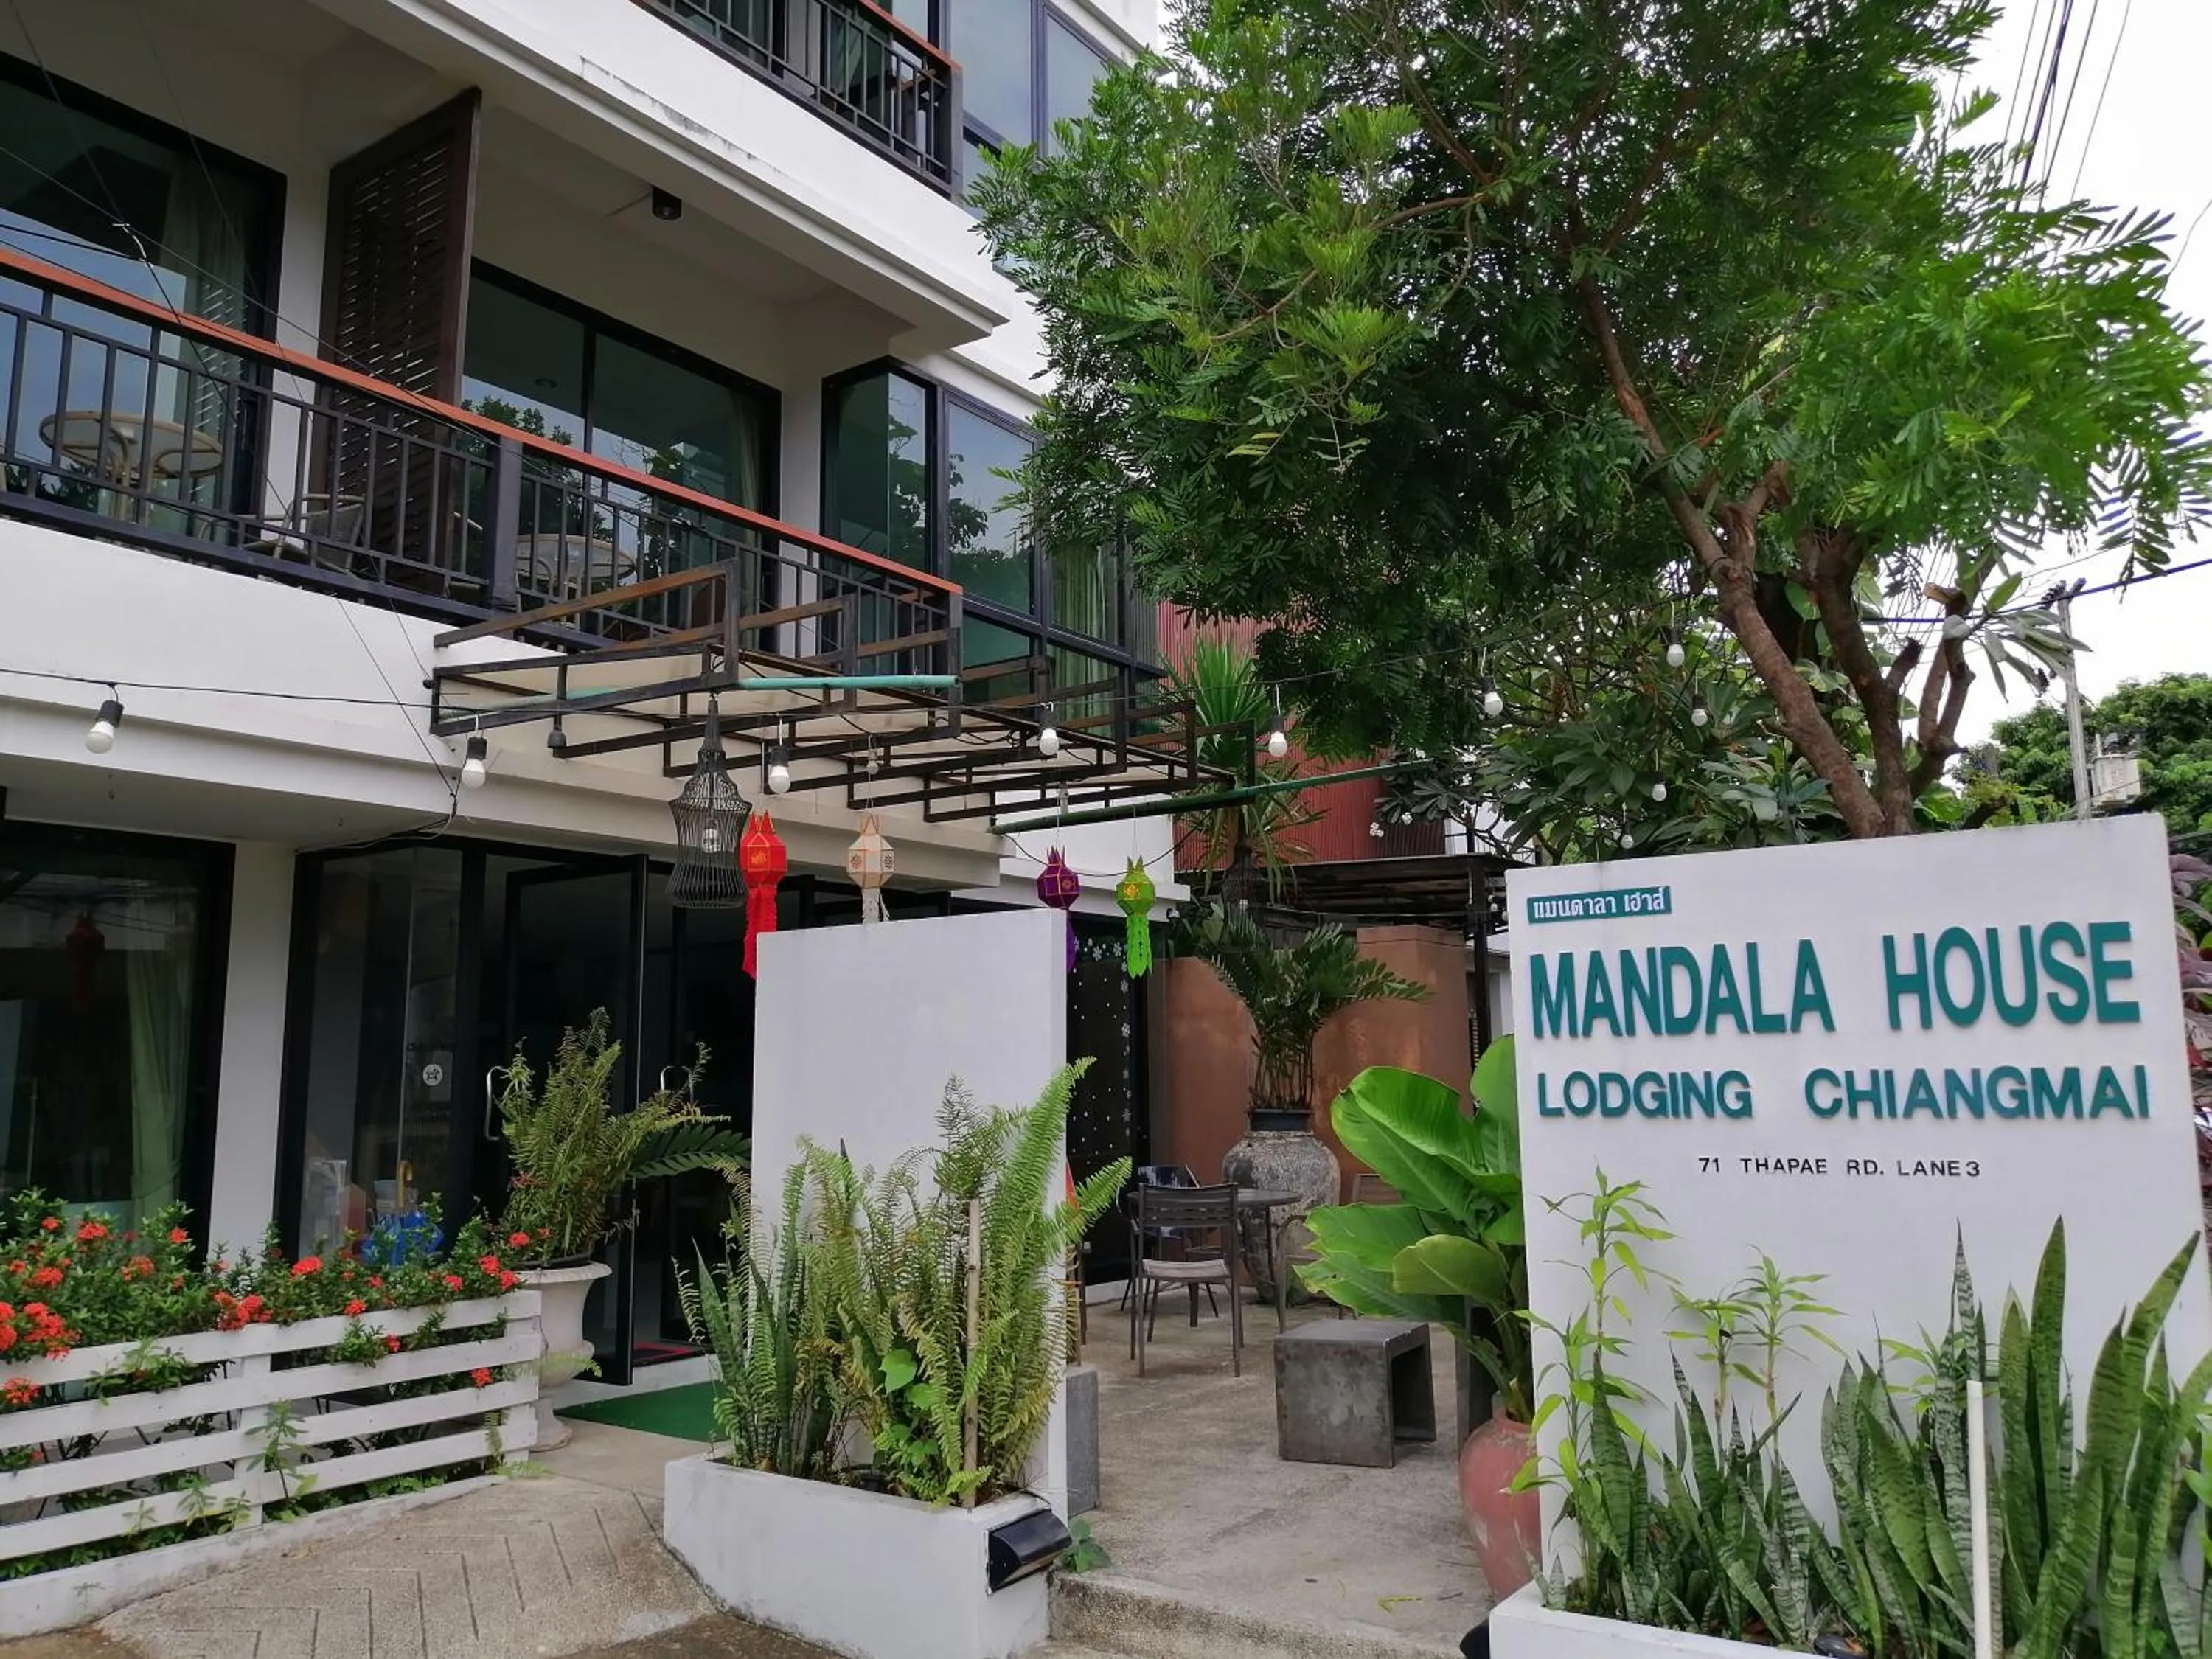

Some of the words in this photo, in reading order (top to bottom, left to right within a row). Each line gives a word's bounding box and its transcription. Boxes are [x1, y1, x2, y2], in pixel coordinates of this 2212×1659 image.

[1533, 895, 1617, 919] แมนดาลา
[1530, 939, 1836, 1039] MANDALA
[1882, 921, 2141, 1032] HOUSE
[1537, 1069, 1753, 1120] LODGING
[1804, 1065, 2150, 1120] CHIANGMAI
[1698, 1157, 1719, 1173] 71
[1739, 1157, 1828, 1174] THAPAE
[1846, 1159, 1885, 1175] RD.
